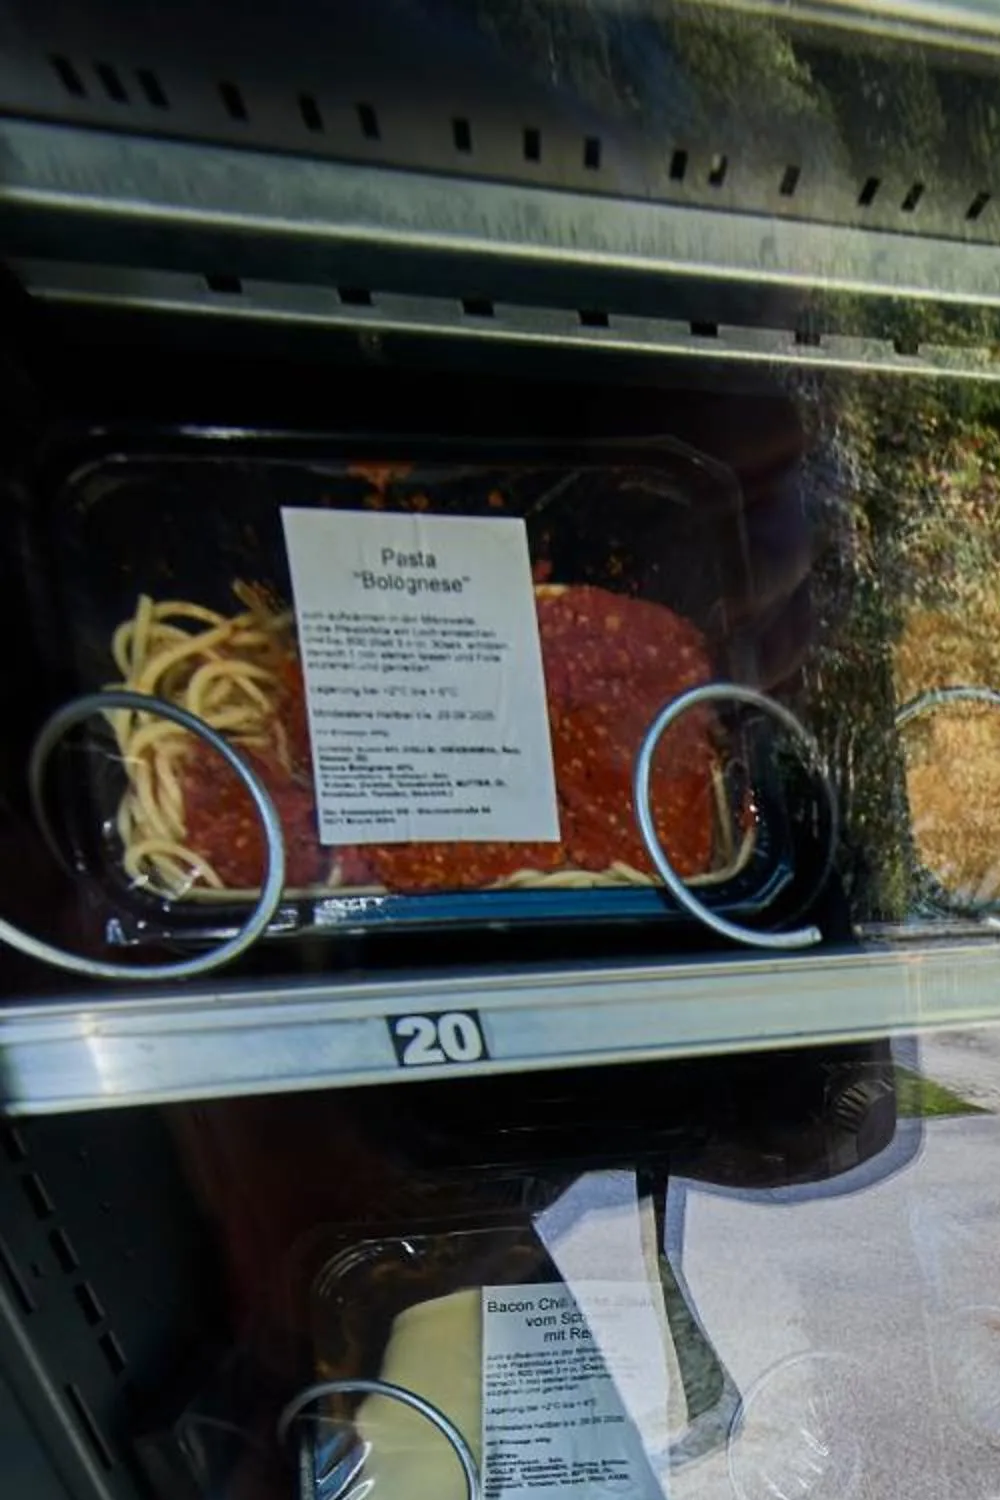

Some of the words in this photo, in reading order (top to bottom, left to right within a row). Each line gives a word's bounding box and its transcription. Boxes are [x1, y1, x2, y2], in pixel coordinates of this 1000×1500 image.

[381, 547, 437, 569] Pasta
[396, 1013, 483, 1064] 20
[487, 1299, 534, 1313] Bacon
[525, 1315, 557, 1328] vom
[543, 1330, 567, 1343] mit
